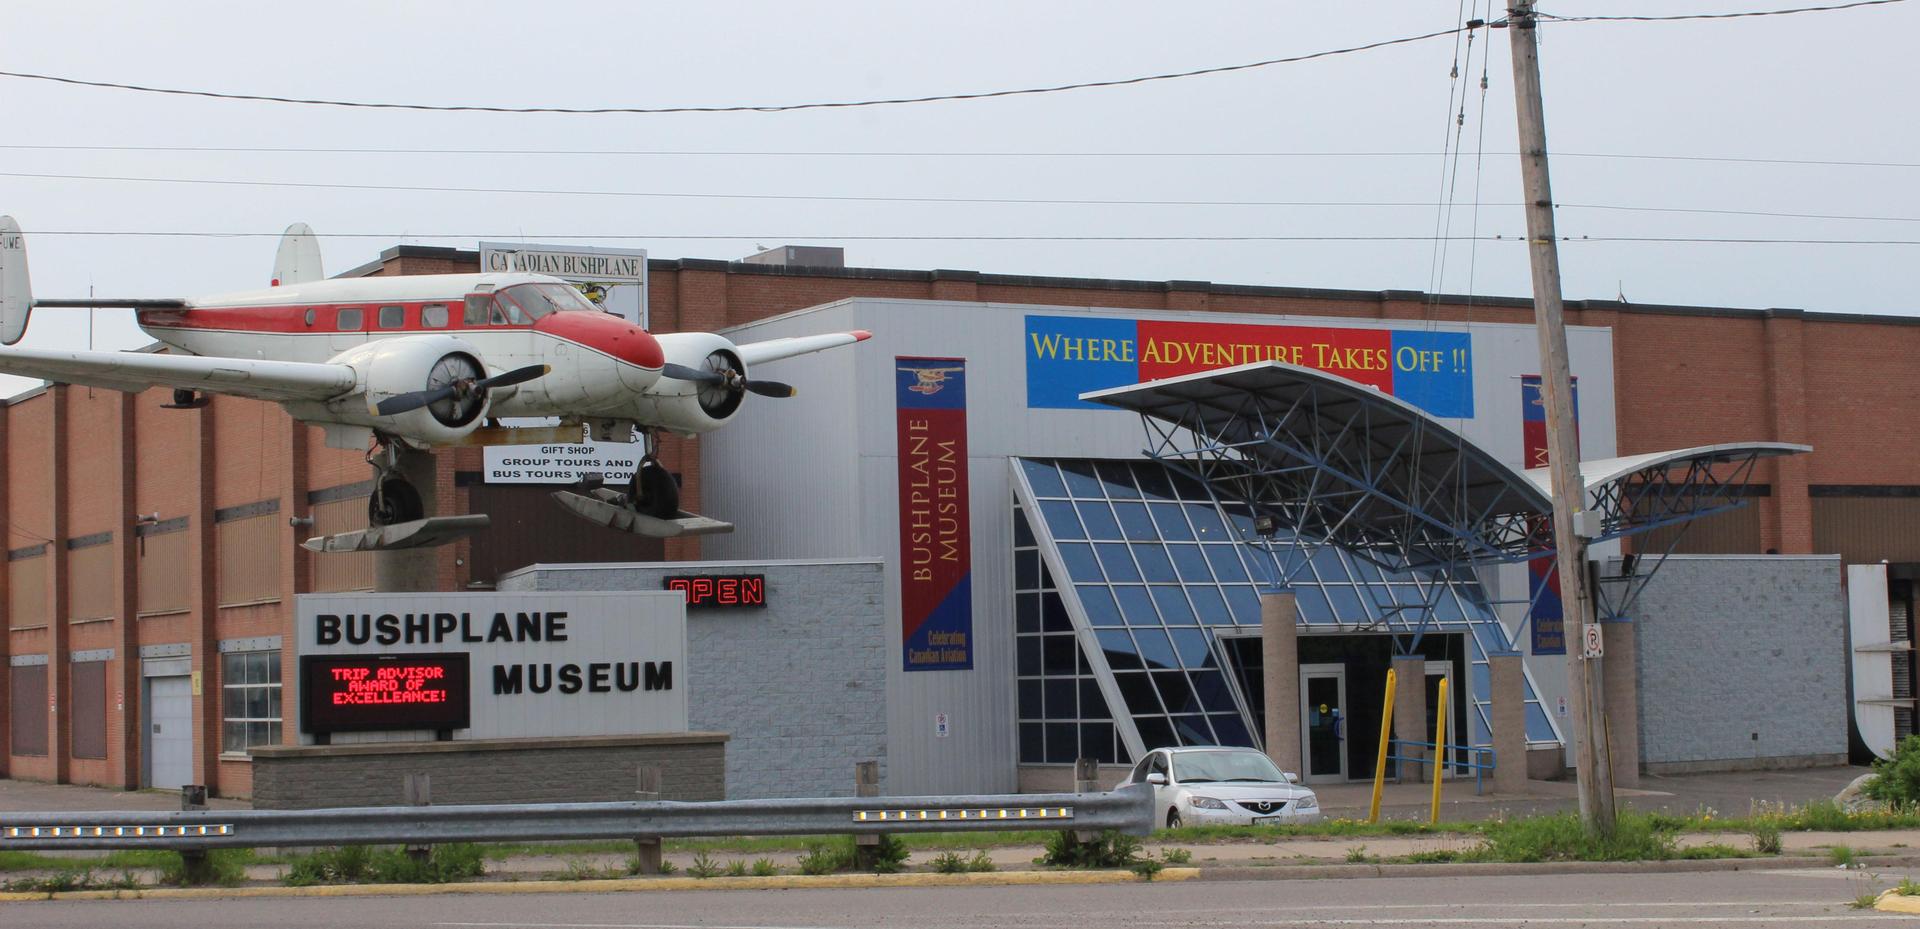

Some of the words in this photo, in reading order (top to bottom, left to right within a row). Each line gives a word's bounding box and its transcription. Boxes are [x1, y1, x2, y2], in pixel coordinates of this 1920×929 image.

[563, 255, 639, 276] BUSHPLANE
[1030, 332, 1134, 362] WHERE
[1141, 337, 1304, 367] ADVENTURE
[1312, 343, 1388, 371] TAKES
[1396, 346, 1444, 372] OFF
[541, 446, 565, 455] GIFT
[567, 446, 594, 455] SHOP
[502, 458, 550, 466] GROUP
[555, 459, 601, 467] TOURS
[493, 470, 521, 478] BUS
[576, 471, 634, 479] WCOM
[910, 419, 932, 581] BUSHPLANE
[937, 440, 958, 561] MUSEUM
[669, 578, 762, 604] OPEN
[316, 612, 568, 645] BUSHPLANE
[331, 668, 370, 681] TRIP
[377, 667, 444, 680] ADVISOR
[492, 661, 672, 695] MUSEUM
[348, 680, 398, 691] AWARD
[405, 679, 425, 691] OF
[333, 690, 446, 705] EXCELLEANCE!
